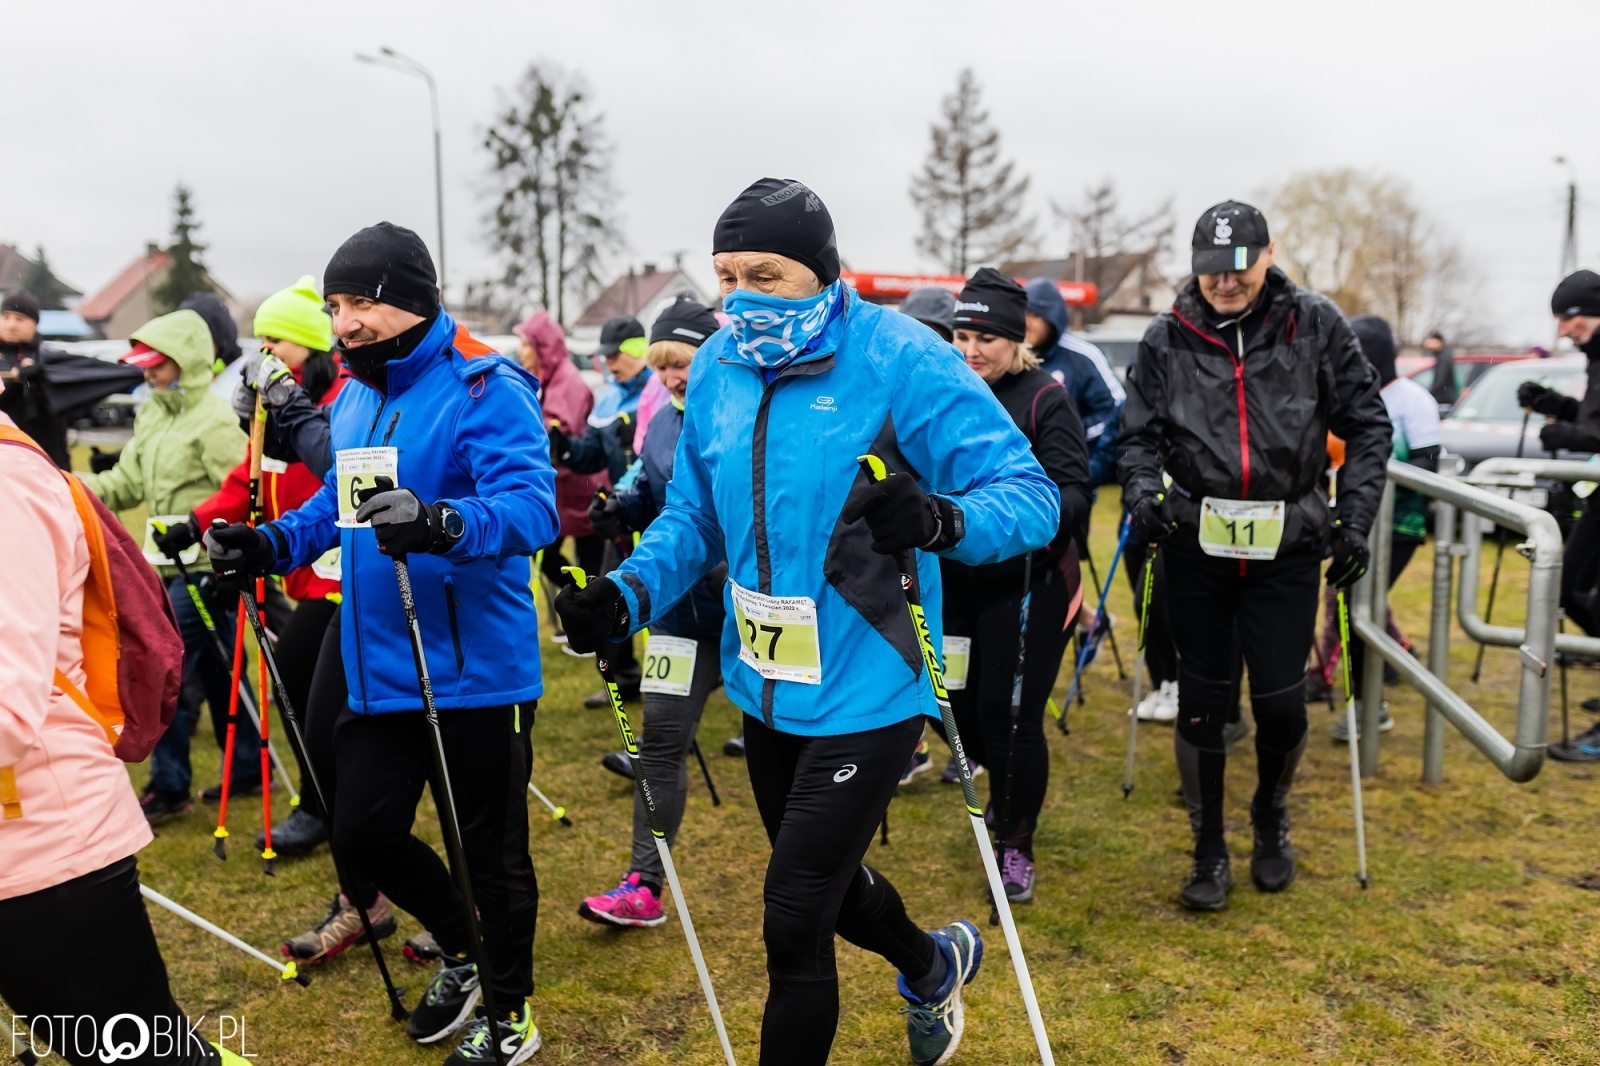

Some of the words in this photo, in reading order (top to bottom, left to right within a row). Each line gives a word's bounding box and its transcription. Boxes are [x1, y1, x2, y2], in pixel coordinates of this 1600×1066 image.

[1226, 520, 1254, 545] 11
[745, 618, 783, 661] 27
[645, 655, 671, 680] 20
[953, 734, 971, 779] CARBON
[641, 778, 656, 812] CARBON
